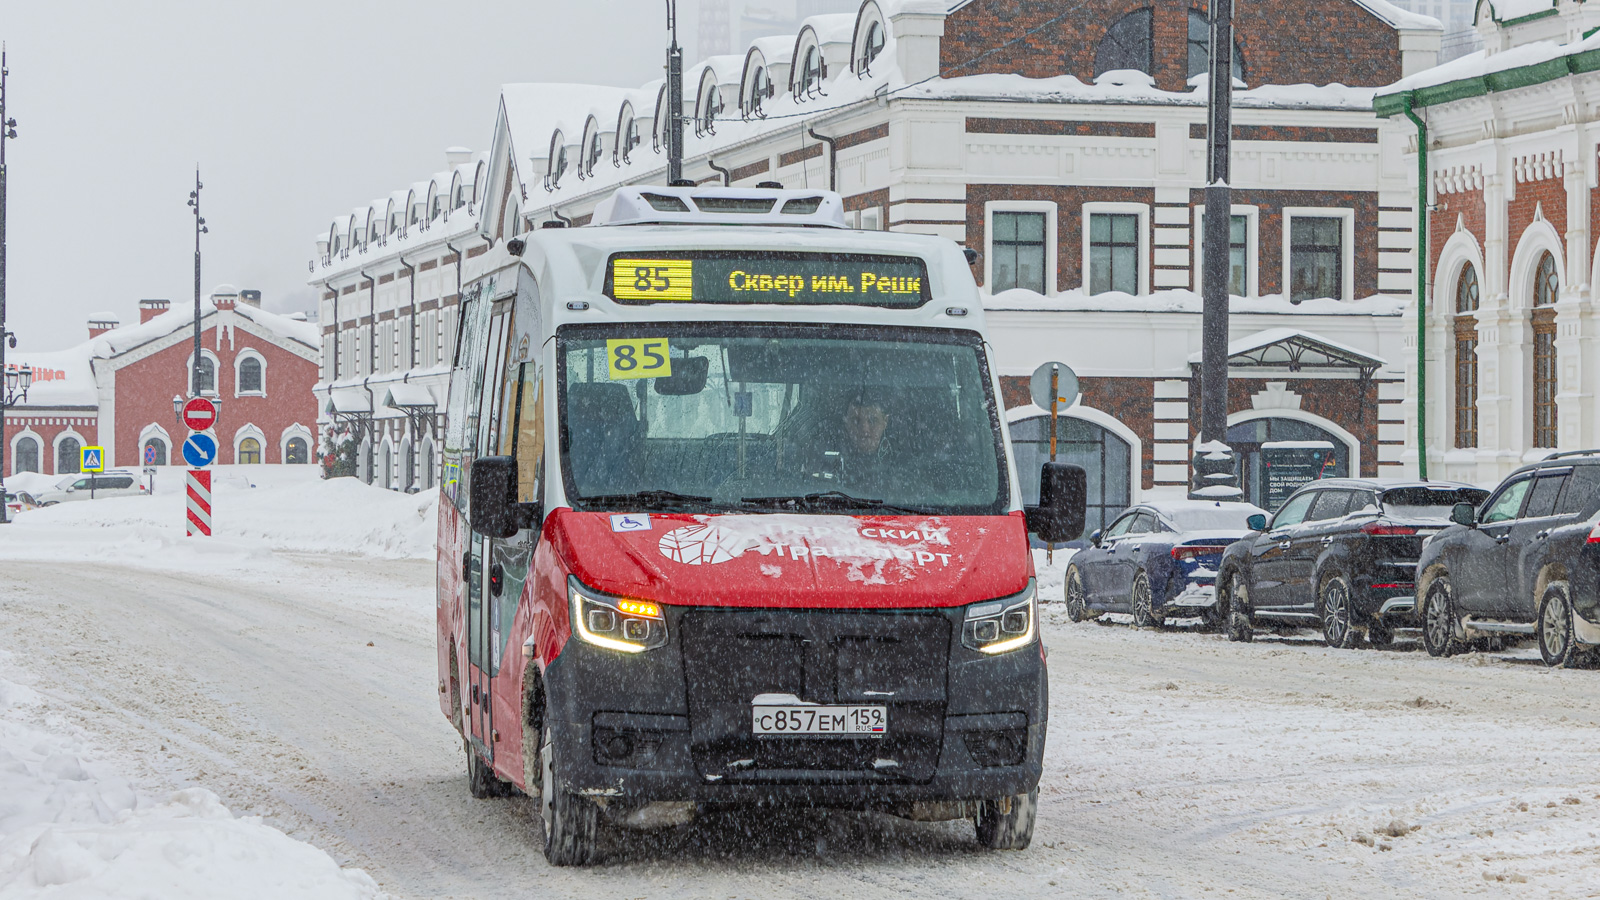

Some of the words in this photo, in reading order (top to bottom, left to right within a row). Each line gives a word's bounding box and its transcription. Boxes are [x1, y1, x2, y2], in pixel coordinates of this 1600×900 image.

[634, 267, 670, 292] 85
[728, 270, 805, 297] Сквер
[811, 275, 854, 292] им.
[613, 343, 665, 371] 85
[760, 710, 845, 731] С857ЕМ
[850, 709, 882, 725] 159
